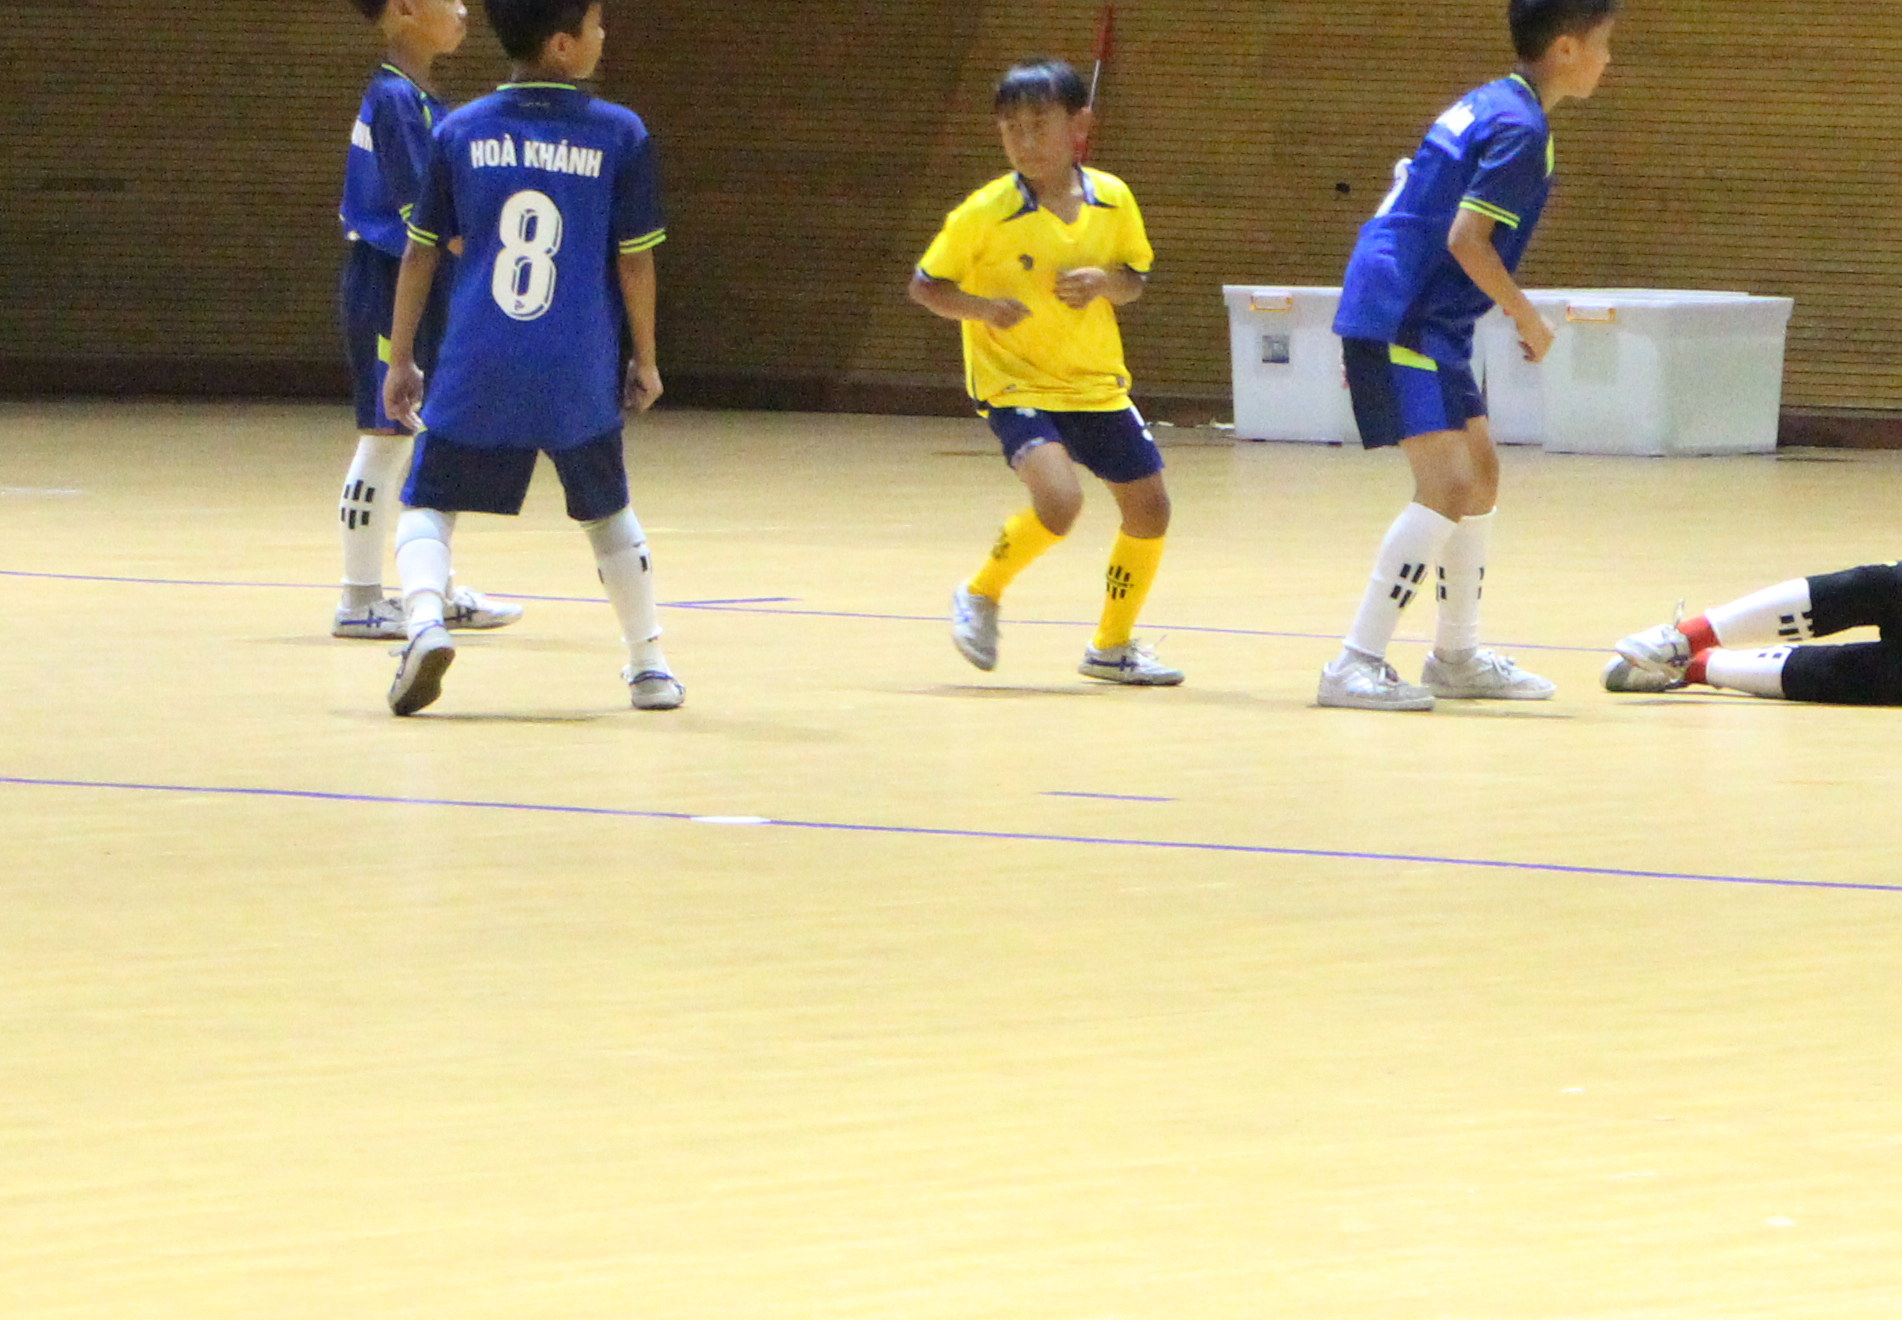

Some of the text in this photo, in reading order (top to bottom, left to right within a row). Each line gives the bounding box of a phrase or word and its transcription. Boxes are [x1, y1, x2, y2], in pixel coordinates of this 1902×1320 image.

[469, 133, 604, 178] HOÀ KHÁNH
[491, 188, 564, 321] 8
